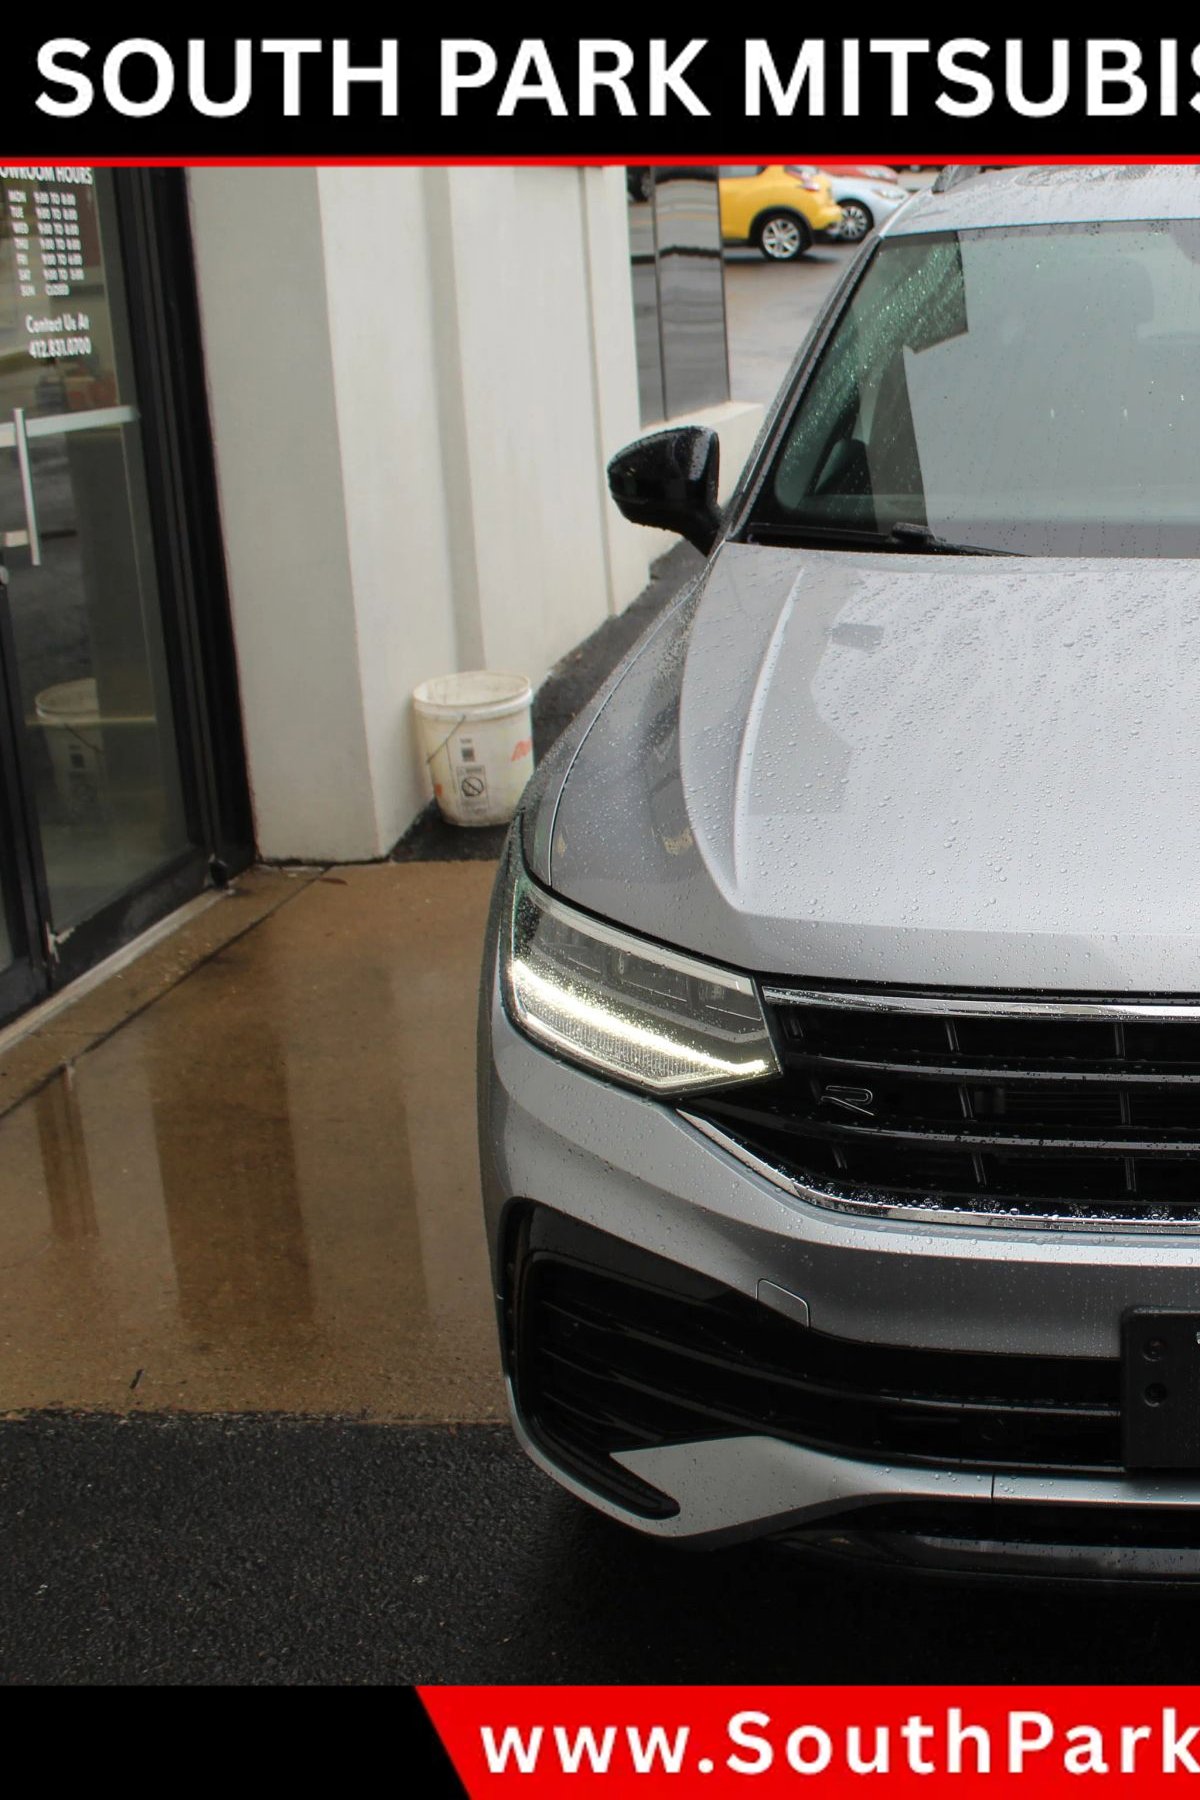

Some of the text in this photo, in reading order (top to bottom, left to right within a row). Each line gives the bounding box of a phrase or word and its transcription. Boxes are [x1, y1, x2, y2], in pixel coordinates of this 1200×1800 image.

[25, 312, 90, 333] Contact Us At
[29, 336, 92, 358] 412.831.0700
